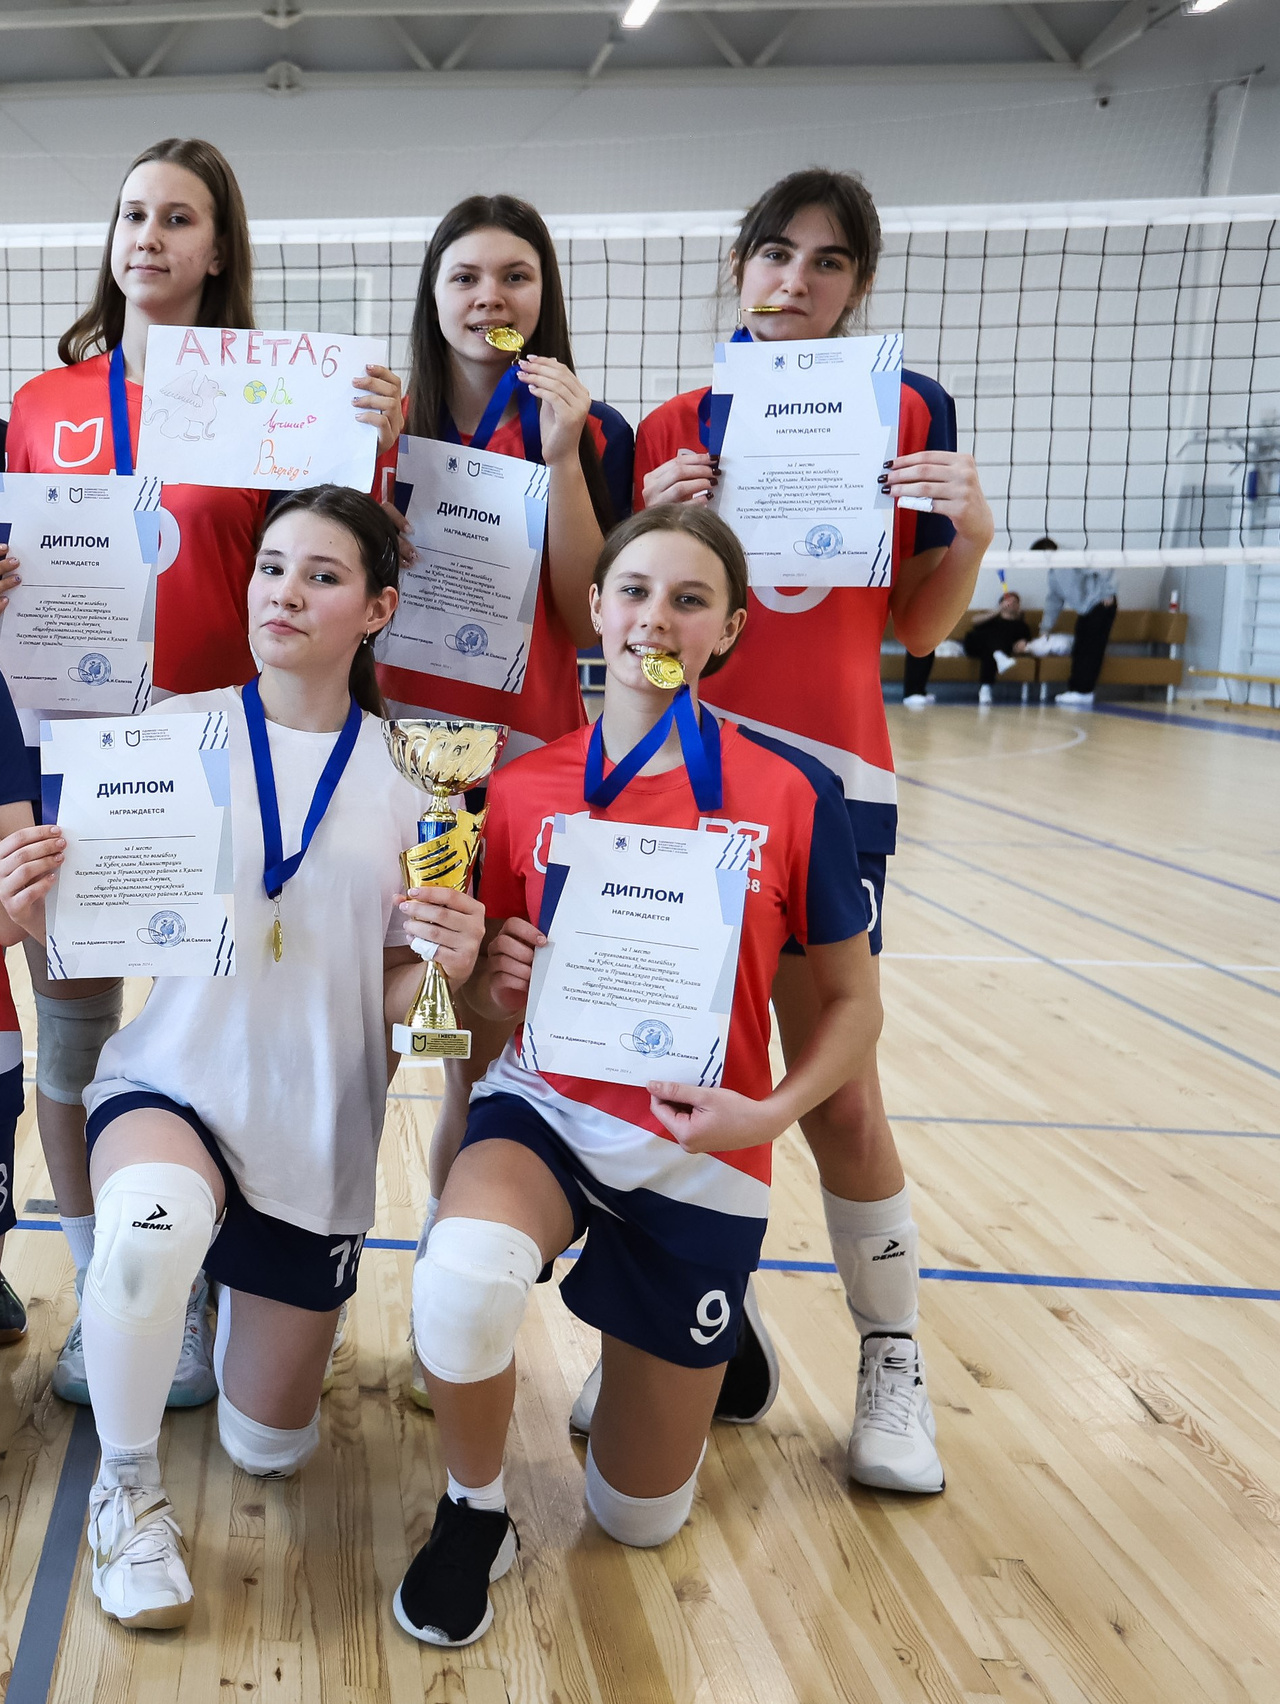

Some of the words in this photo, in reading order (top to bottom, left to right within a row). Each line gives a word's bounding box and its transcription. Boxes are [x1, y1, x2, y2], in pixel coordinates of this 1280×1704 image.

[765, 402, 842, 418] ДИПЛОМ
[437, 501, 501, 526] ДИПЛОМ
[40, 535, 109, 549] ДИПЛОМ
[444, 527, 489, 542] НАГРАЖДАЕТСЯ
[97, 780, 174, 798] ДИПЛОМ
[601, 882, 684, 904] ДИПЛОМ
[612, 909, 670, 921] НАГРАЖДАЕТСЯ
[132, 1219, 173, 1232] DEMIX
[871, 1249, 906, 1262] DEMIX
[689, 1289, 732, 1345] 9
